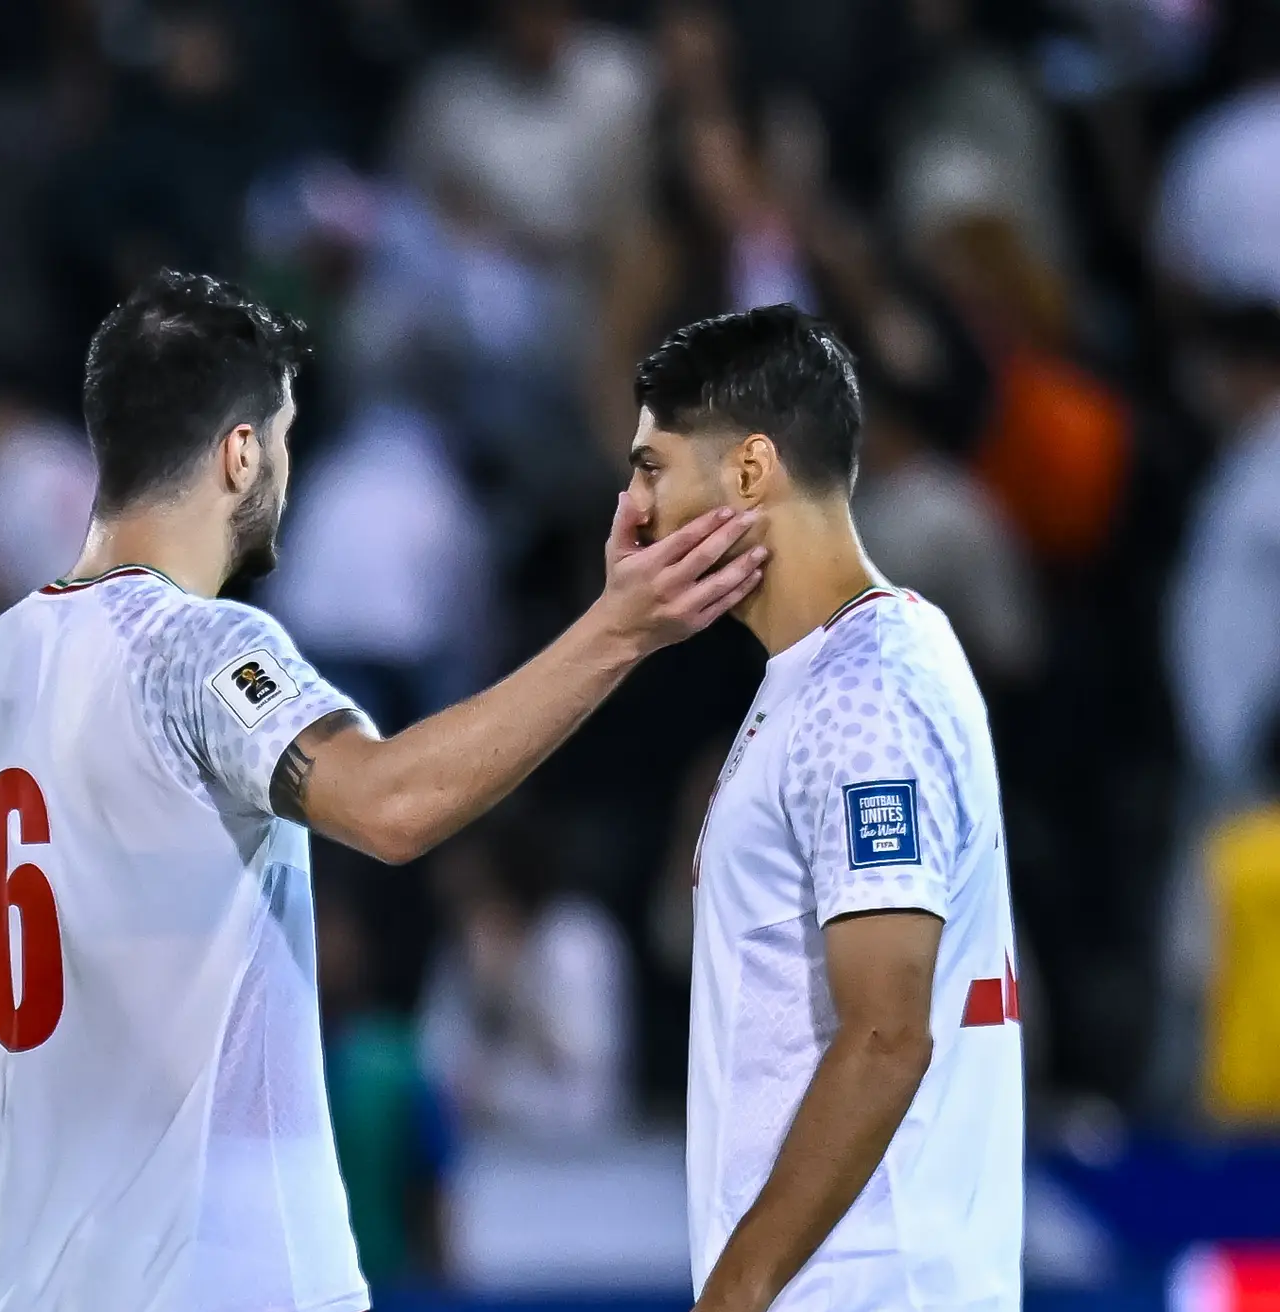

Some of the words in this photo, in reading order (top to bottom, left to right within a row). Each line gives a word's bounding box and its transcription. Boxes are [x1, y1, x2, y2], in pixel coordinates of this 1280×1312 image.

[859, 795, 902, 809] FOOTBALL
[860, 806, 904, 825] UNITES
[877, 822, 907, 836] World
